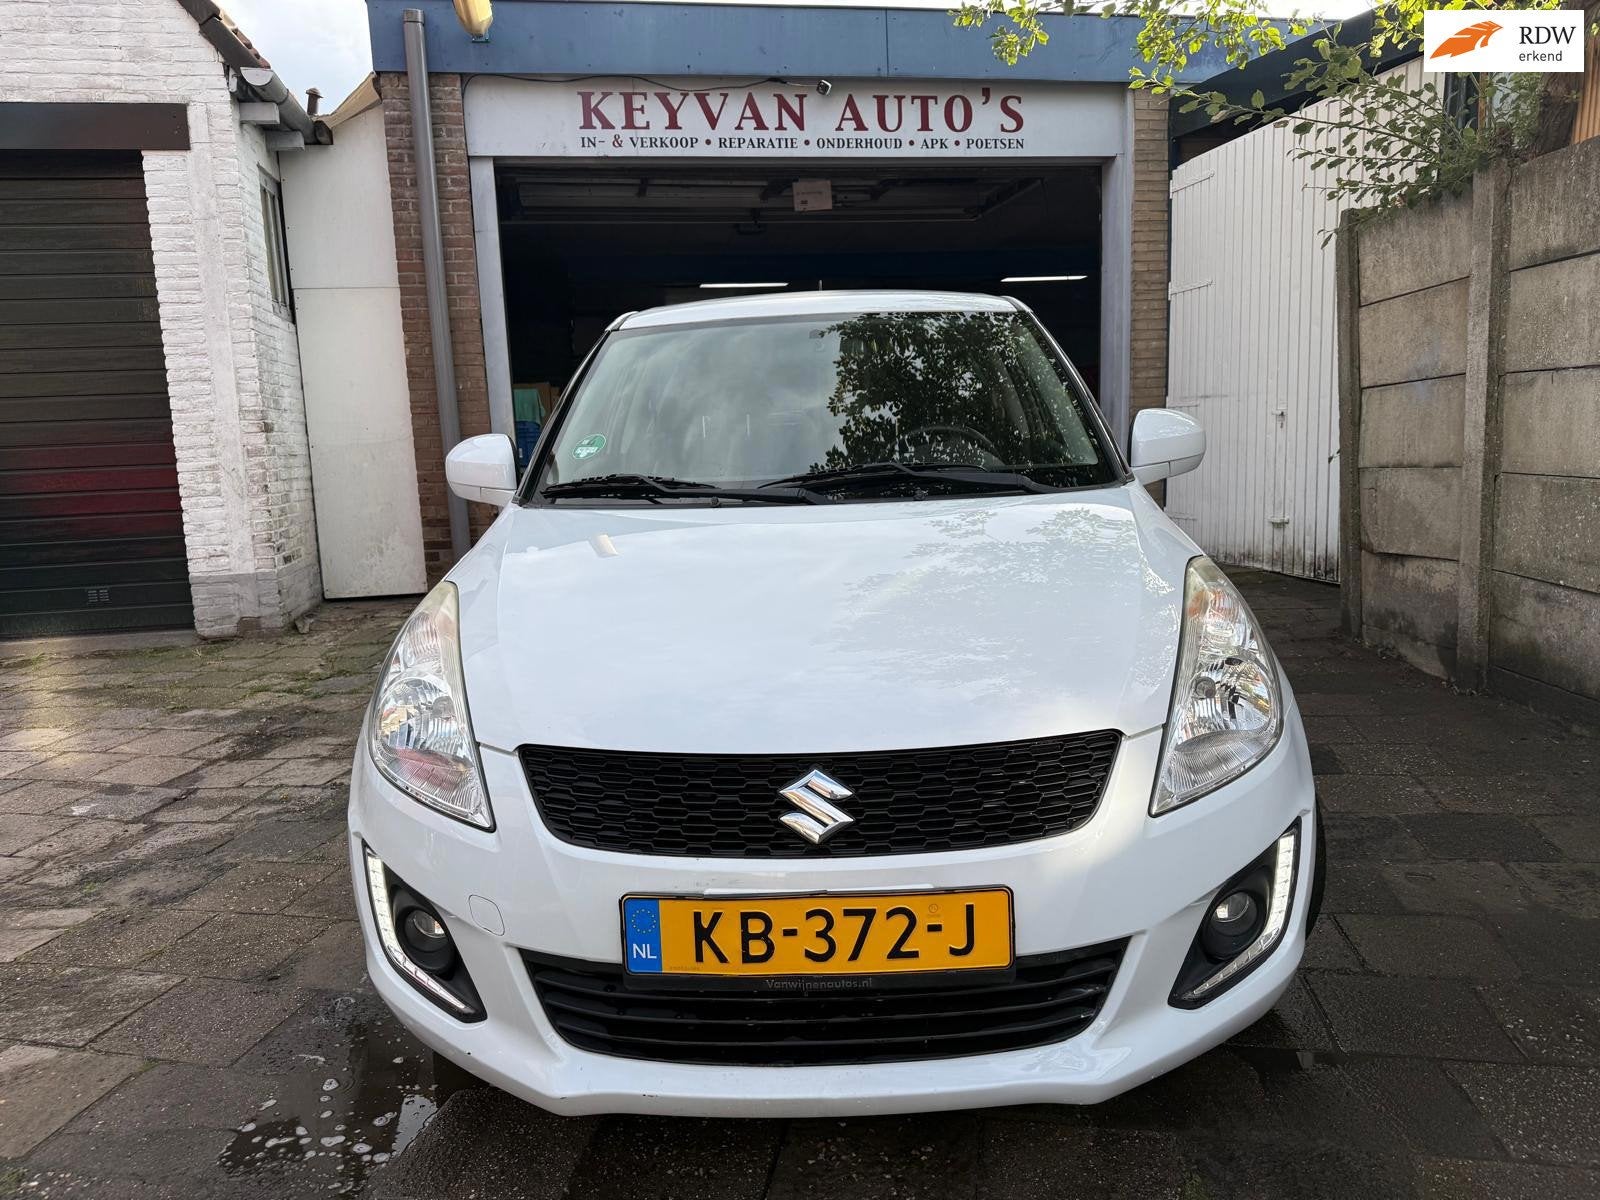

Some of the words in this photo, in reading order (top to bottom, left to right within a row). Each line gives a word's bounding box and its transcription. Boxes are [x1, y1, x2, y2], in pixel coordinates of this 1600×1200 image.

[577, 91, 807, 131] KEYVAN
[835, 87, 1024, 133] AUTO'S
[581, 136, 605, 148] IN-
[612, 134, 623, 148] &
[629, 136, 699, 149] VERKOOP
[718, 137, 798, 149] REPARATIE
[816, 137, 902, 150] ONDERHOUD
[920, 138, 948, 150] APK
[966, 138, 1024, 150] POETSEN
[693, 904, 976, 964] KB-372-J
[632, 943, 657, 959] NL
